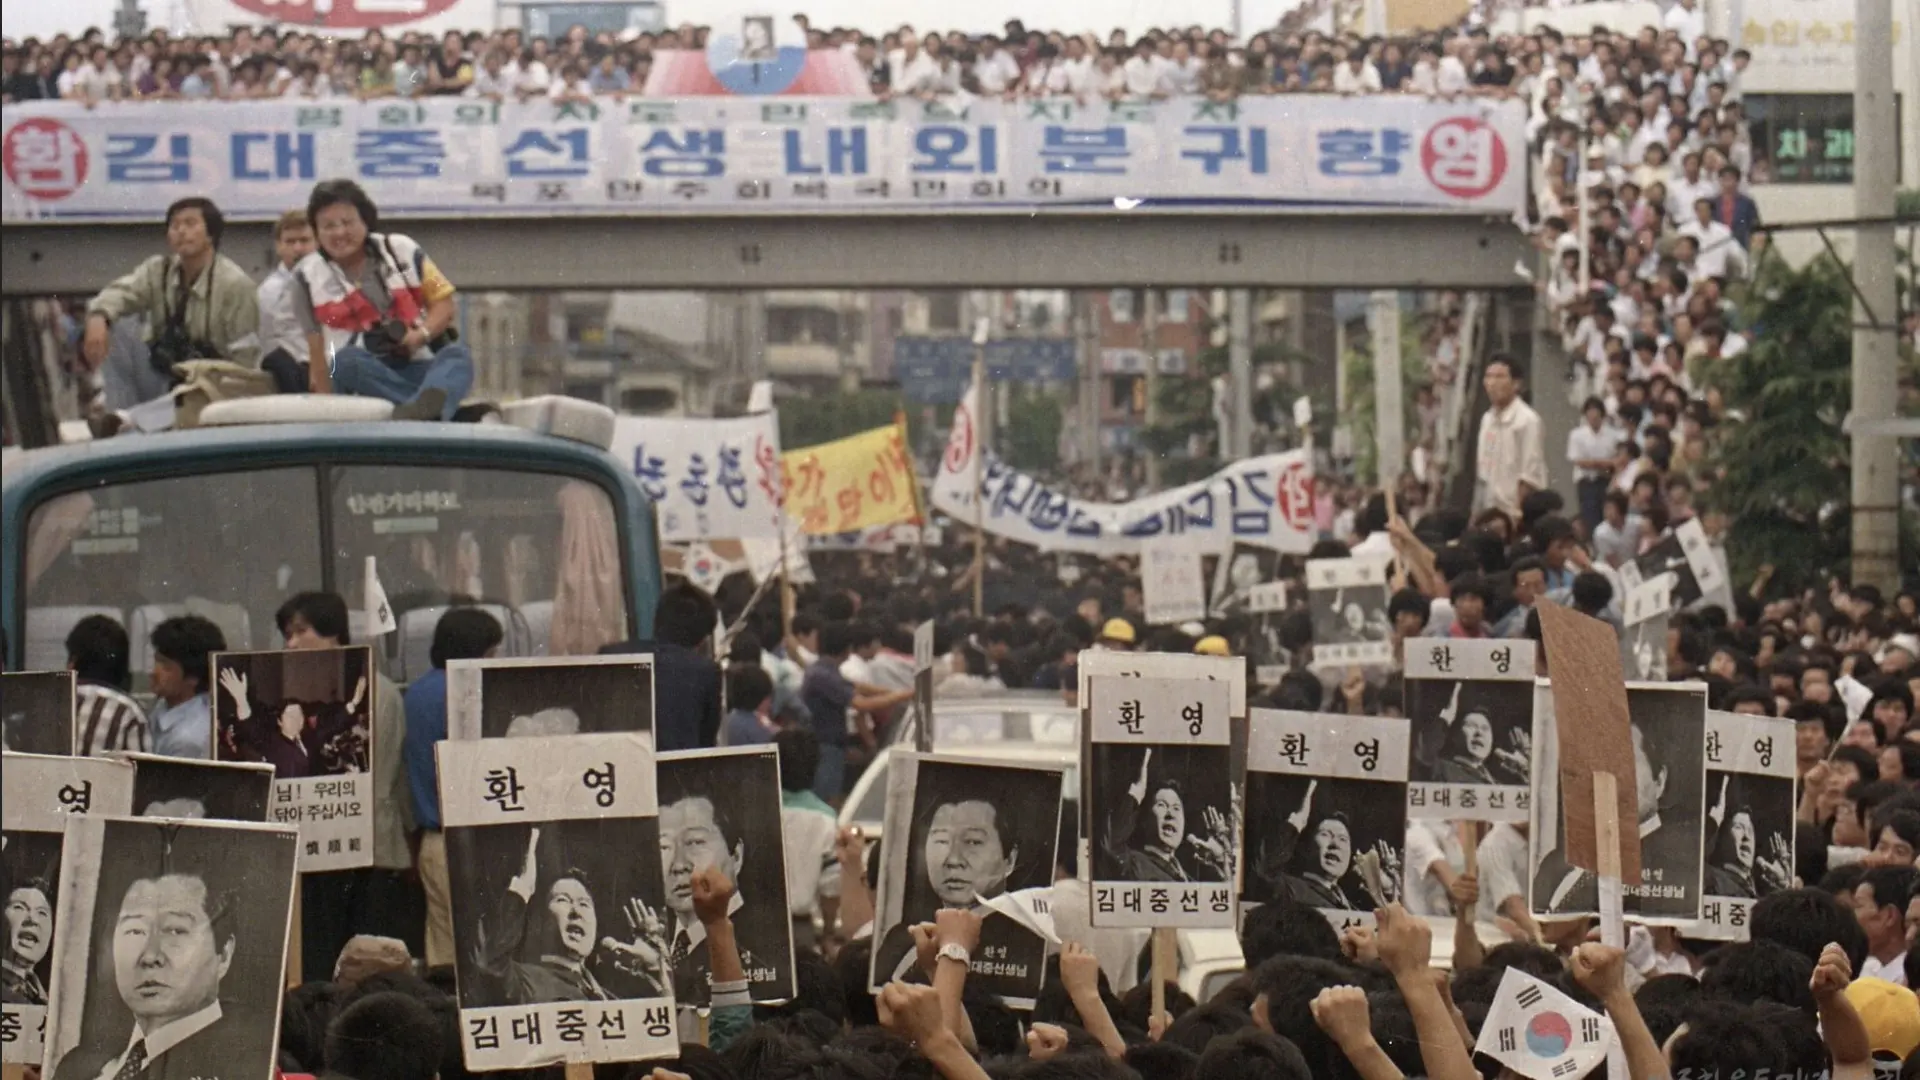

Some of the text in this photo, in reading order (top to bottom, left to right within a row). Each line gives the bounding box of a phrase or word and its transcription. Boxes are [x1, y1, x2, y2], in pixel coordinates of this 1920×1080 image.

[1428, 121, 1498, 192] 영
[314, 780, 356, 798] 우리의
[307, 802, 362, 821] 주십시오
[1097, 888, 1231, 913] 김대중선생
[967, 960, 1028, 978] 대중선생님
[469, 1005, 673, 1050] 김대중선생
